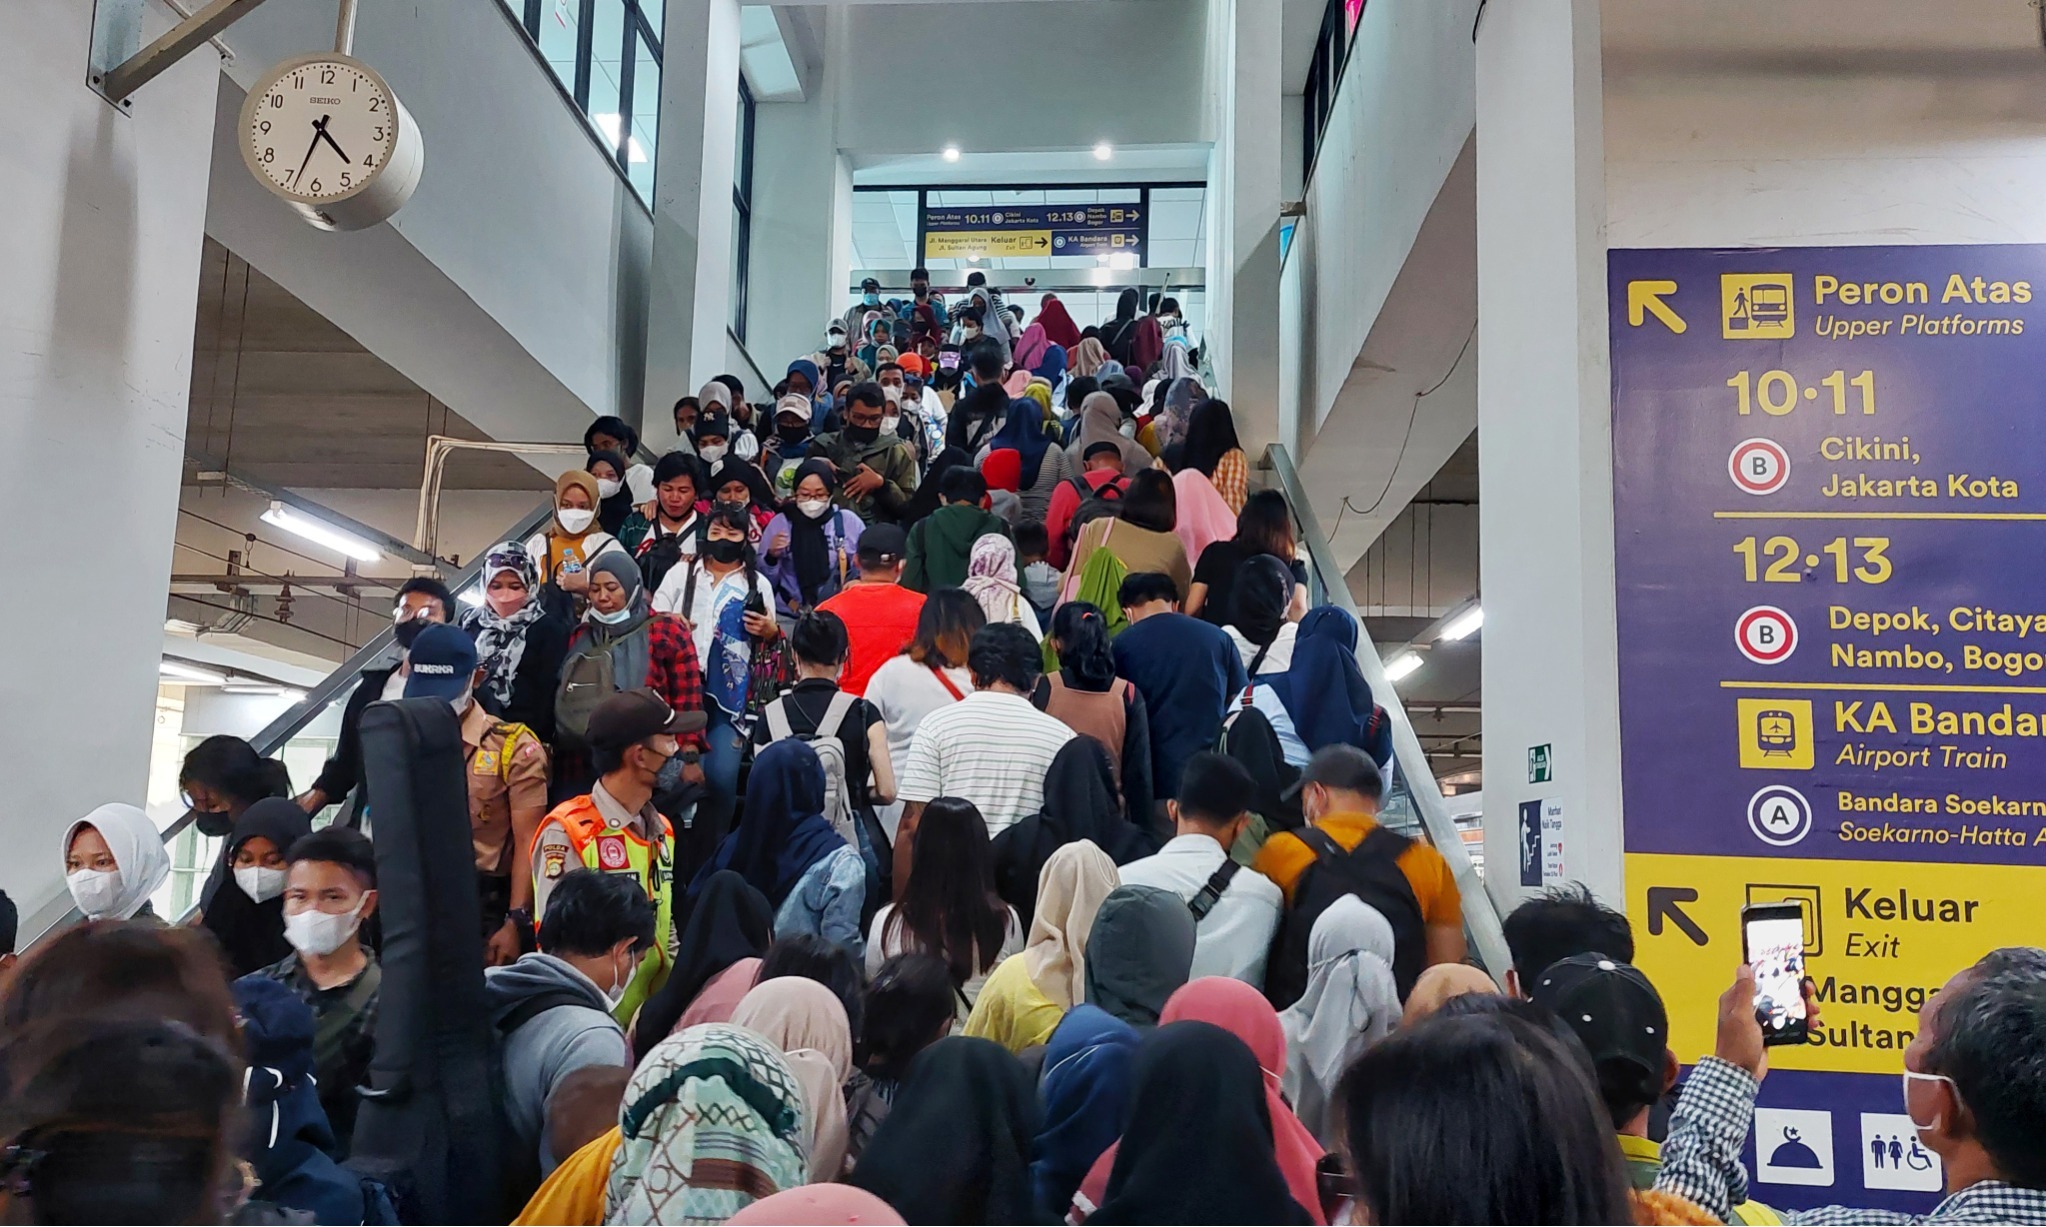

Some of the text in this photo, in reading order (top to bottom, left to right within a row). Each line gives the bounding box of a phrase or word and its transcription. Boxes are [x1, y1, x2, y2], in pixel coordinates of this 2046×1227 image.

[294, 76, 304, 90] 11
[320, 70, 336, 85] 12
[270, 94, 284, 109] 10
[309, 96, 341, 105] SEIKO
[368, 97, 379, 112] 2
[259, 120, 272, 135] 9
[372, 126, 384, 142] 3
[263, 147, 275, 163] 8
[363, 154, 374, 168] 4
[284, 169, 295, 183] 7
[310, 177, 322, 192] 6
[339, 172, 351, 187] 5
[964, 214, 990, 224] 10.11
[1046, 212, 1074, 222] 12.13
[1814, 273, 2032, 305] Peron Atas
[1815, 314, 2024, 340] Upper Platforms
[1820, 436, 1920, 464] Cikini,
[1752, 457, 1767, 475] B
[1821, 473, 2019, 499] Jakarta Kota
[1829, 605, 1940, 636] Depok,
[1759, 626, 1774, 644] B
[1830, 643, 2046, 677] Nambo, Bogo
[1834, 700, 1898, 734] KA
[1835, 743, 2008, 771] Airport Train
[1838, 791, 1939, 814] Bandara
[1769, 805, 1790, 825] A
[1838, 821, 2027, 847] Soekarno-Hatta
[1845, 887, 1979, 923] Keluar
[1845, 933, 1901, 958] Exit
